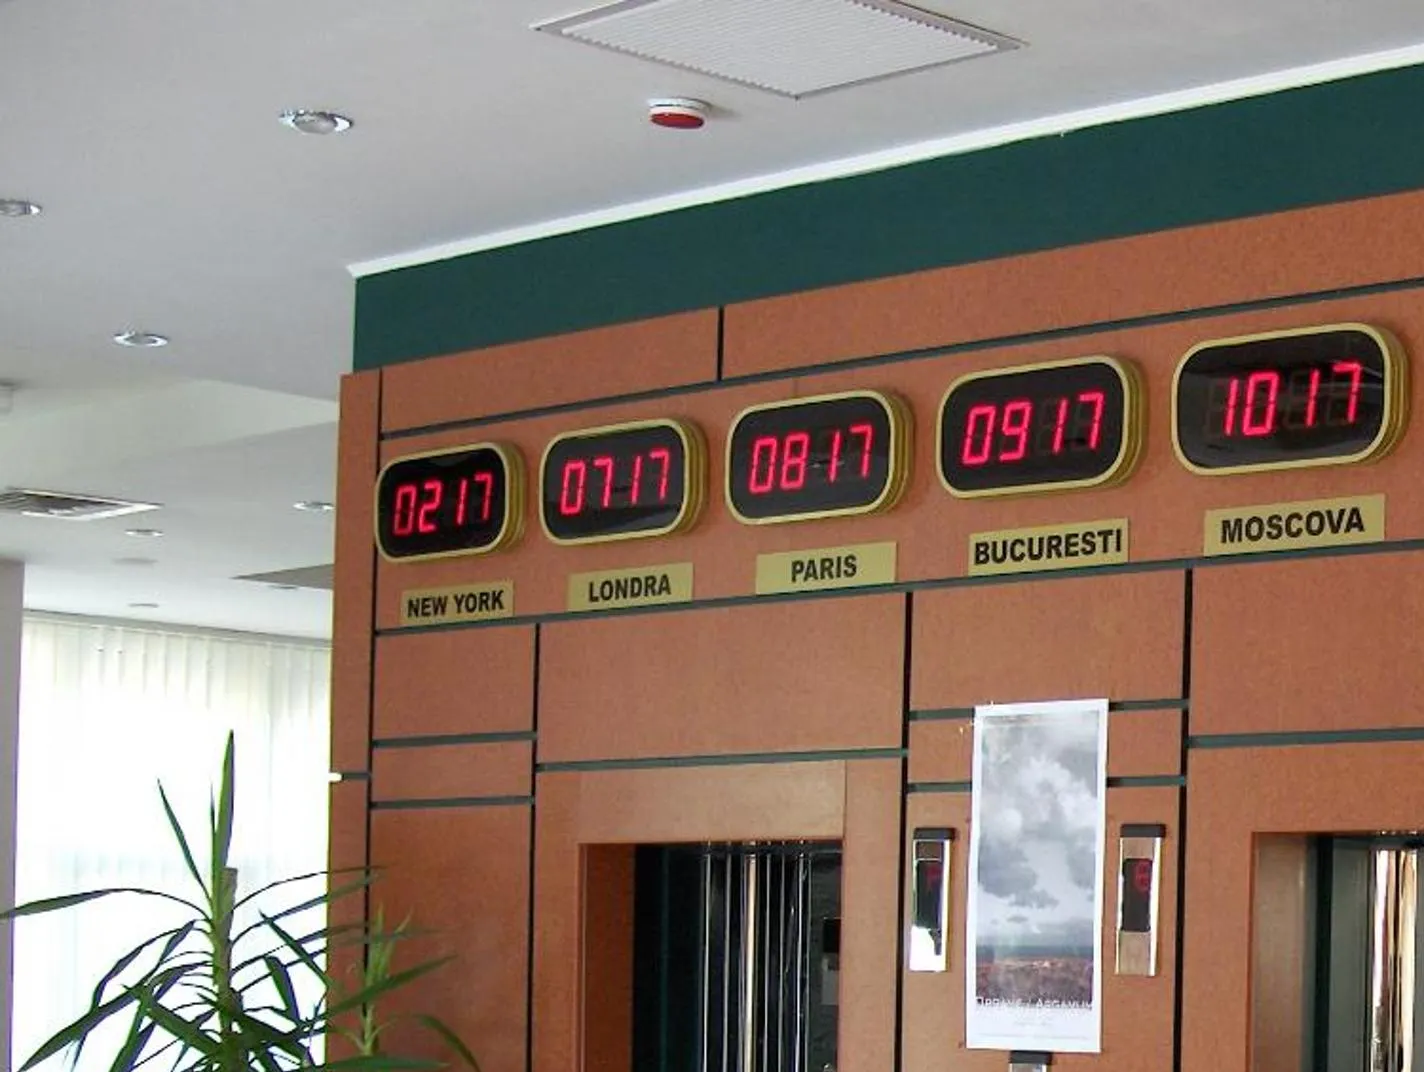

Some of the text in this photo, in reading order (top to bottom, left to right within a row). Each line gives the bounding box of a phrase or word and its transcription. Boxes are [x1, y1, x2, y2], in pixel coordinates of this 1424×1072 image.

[1221, 507, 1365, 543] MOSCOVA
[974, 528, 1122, 565] BUCURESTI
[791, 555, 857, 583] PARIS
[588, 573, 671, 602] LONDRA
[407, 589, 504, 618] NEW YORK
